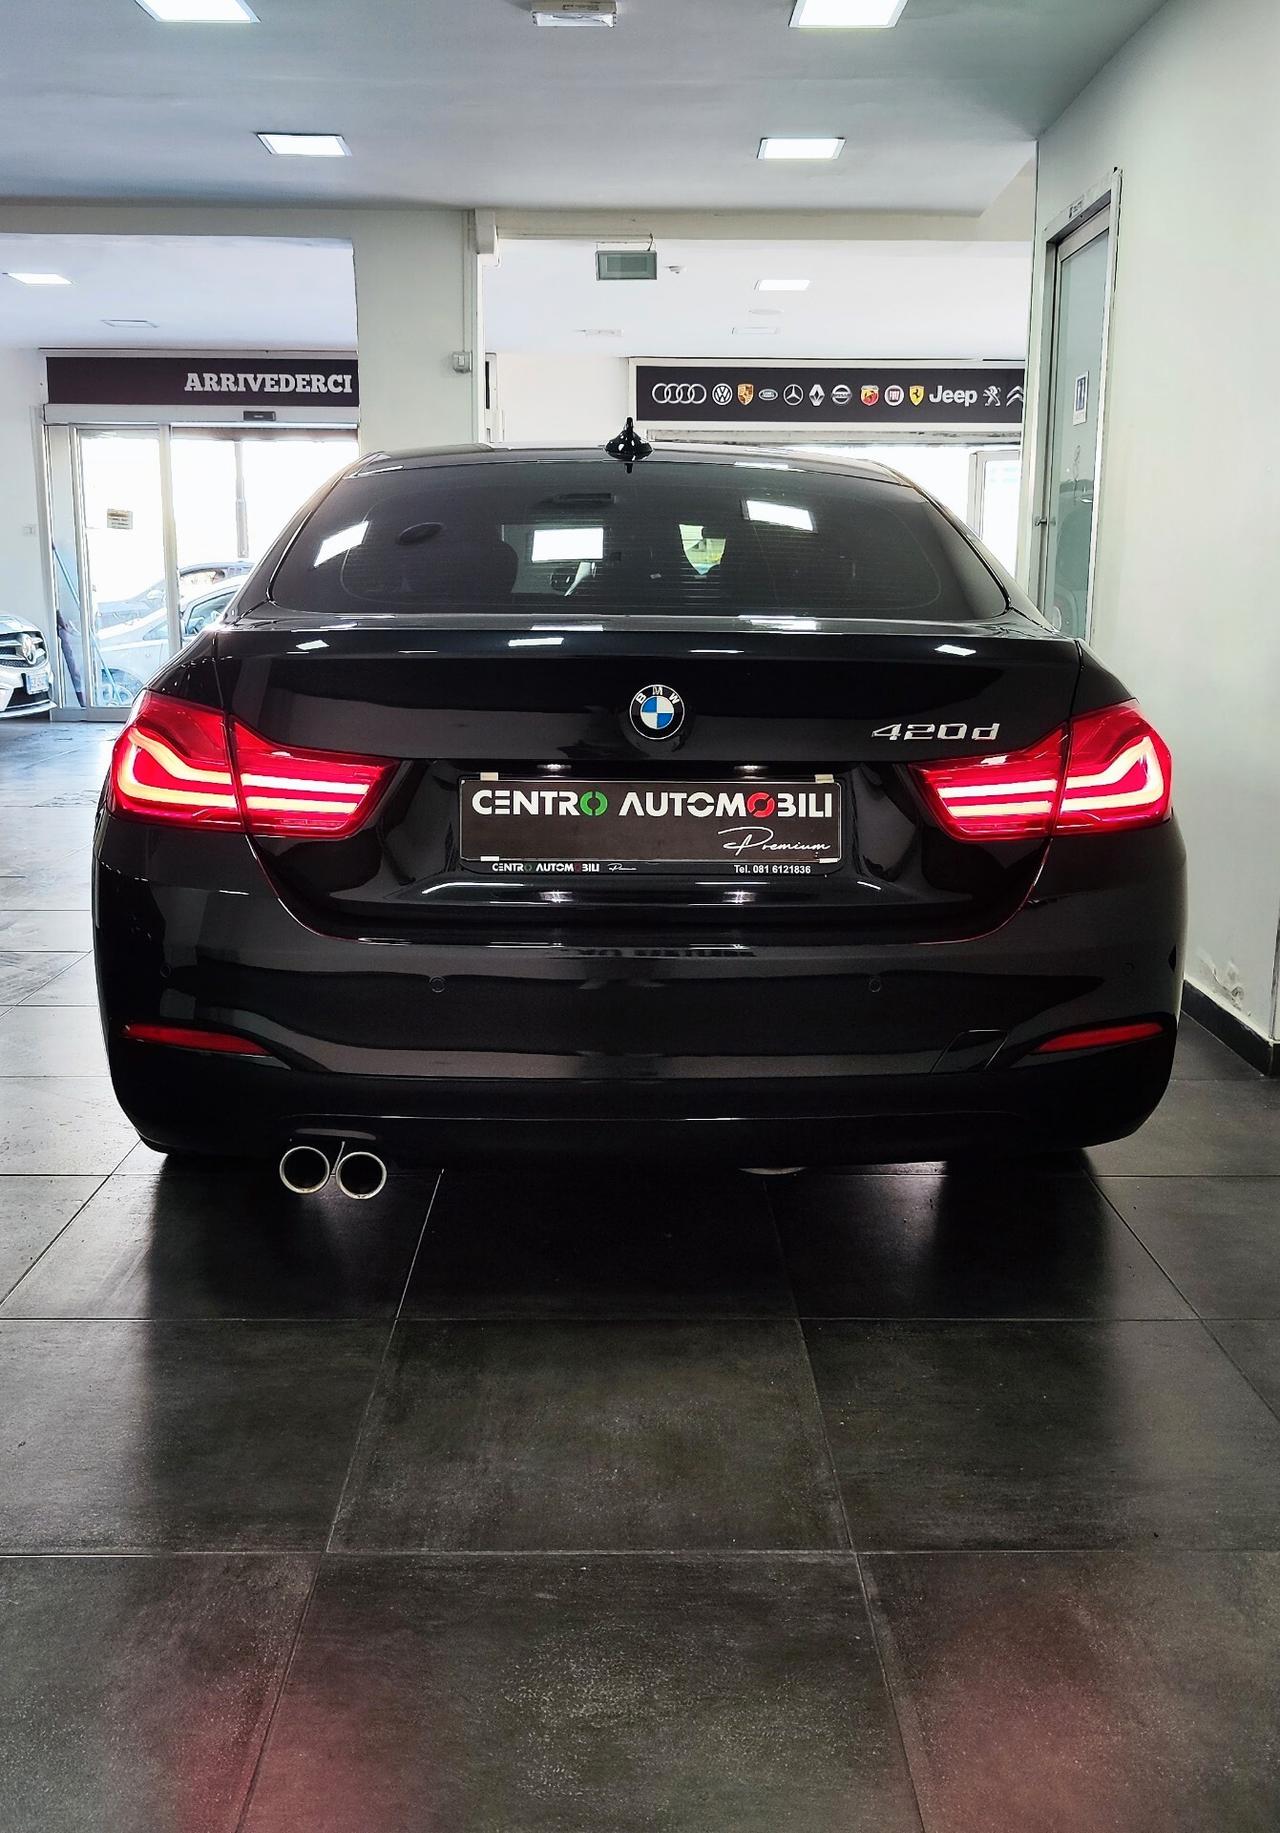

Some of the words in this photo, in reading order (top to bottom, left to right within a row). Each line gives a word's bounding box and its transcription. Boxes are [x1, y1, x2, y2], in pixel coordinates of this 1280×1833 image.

[184, 373, 352, 393] ARRIVEDERCI
[929, 385, 977, 407] Jeep
[635, 685, 680, 704] BMW
[872, 723, 1000, 741] 420d
[472, 789, 608, 816] CENTRO
[618, 791, 833, 818] AUTOMOBILI
[718, 826, 831, 856] Premium
[734, 864, 750, 874] Tel.
[753, 864, 769, 874] 081
[772, 864, 811, 875] 6121836
